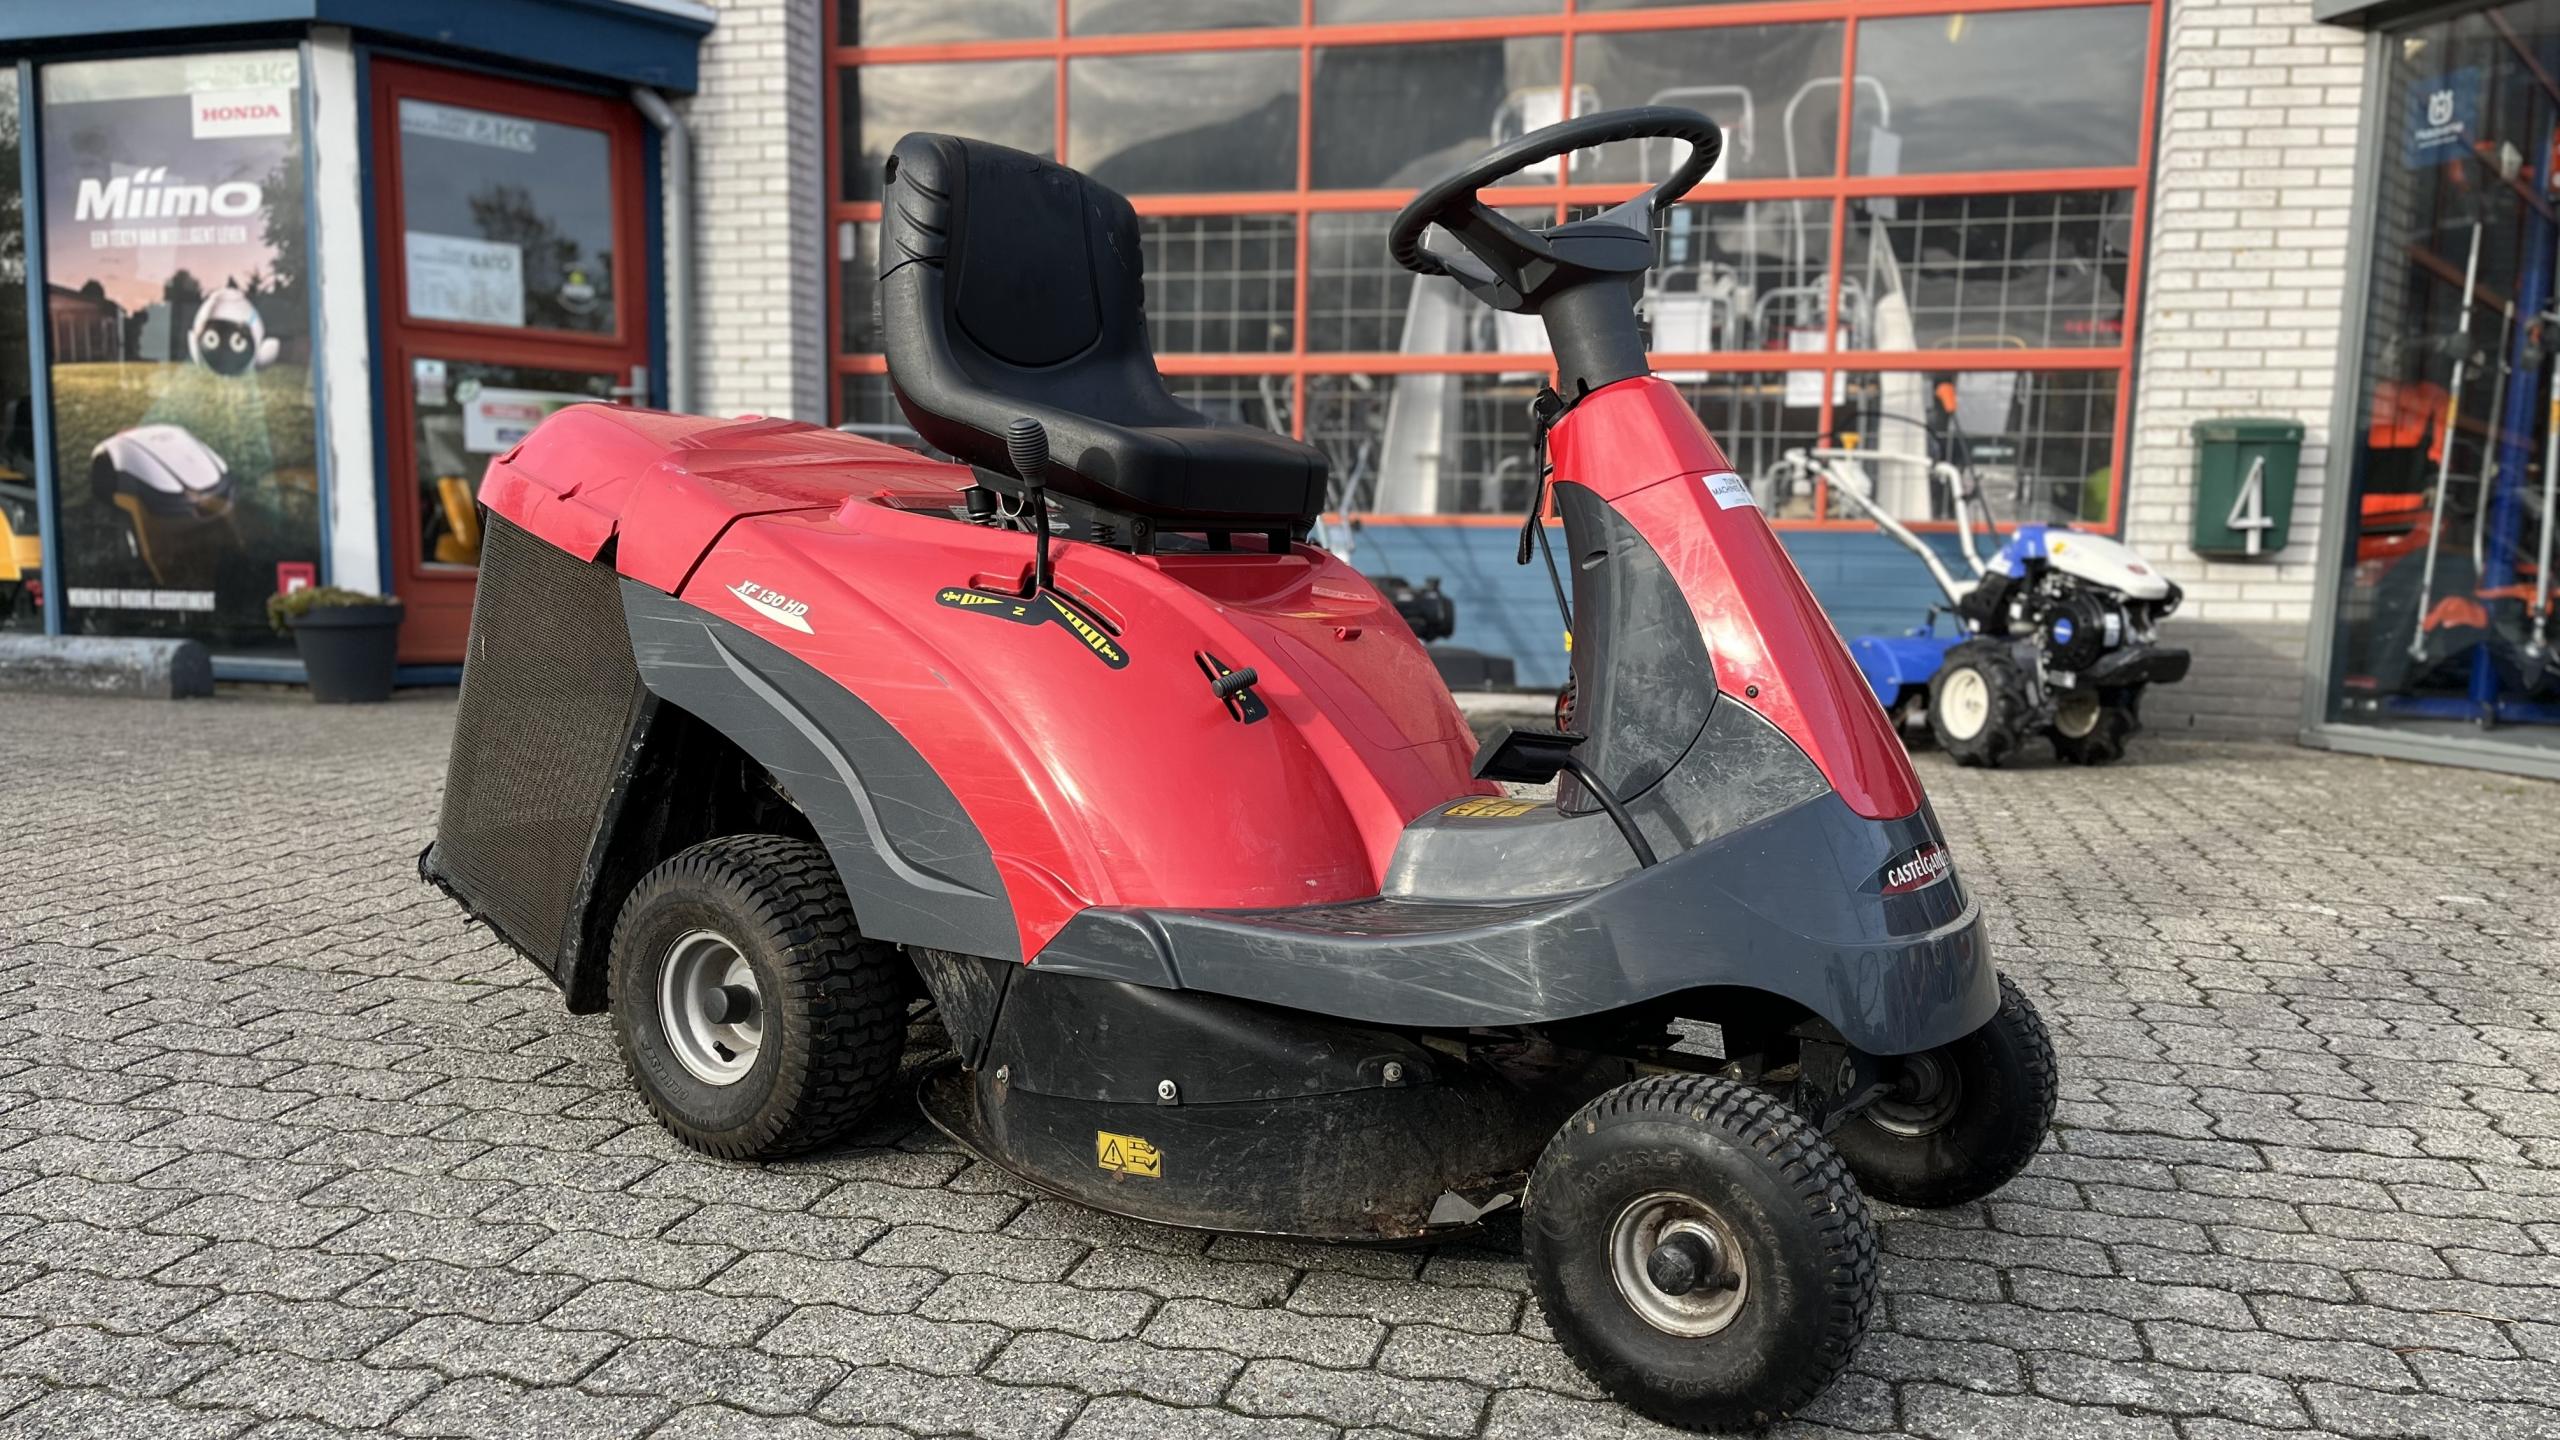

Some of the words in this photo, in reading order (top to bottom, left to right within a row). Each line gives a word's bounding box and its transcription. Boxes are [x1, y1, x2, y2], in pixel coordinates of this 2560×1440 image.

[202, 105, 280, 121] HONDA
[75, 166, 263, 221] Miimo
[2226, 456, 2274, 555] 4
[736, 580, 761, 595] XF
[757, 589, 786, 607] 130
[782, 599, 809, 616] HD
